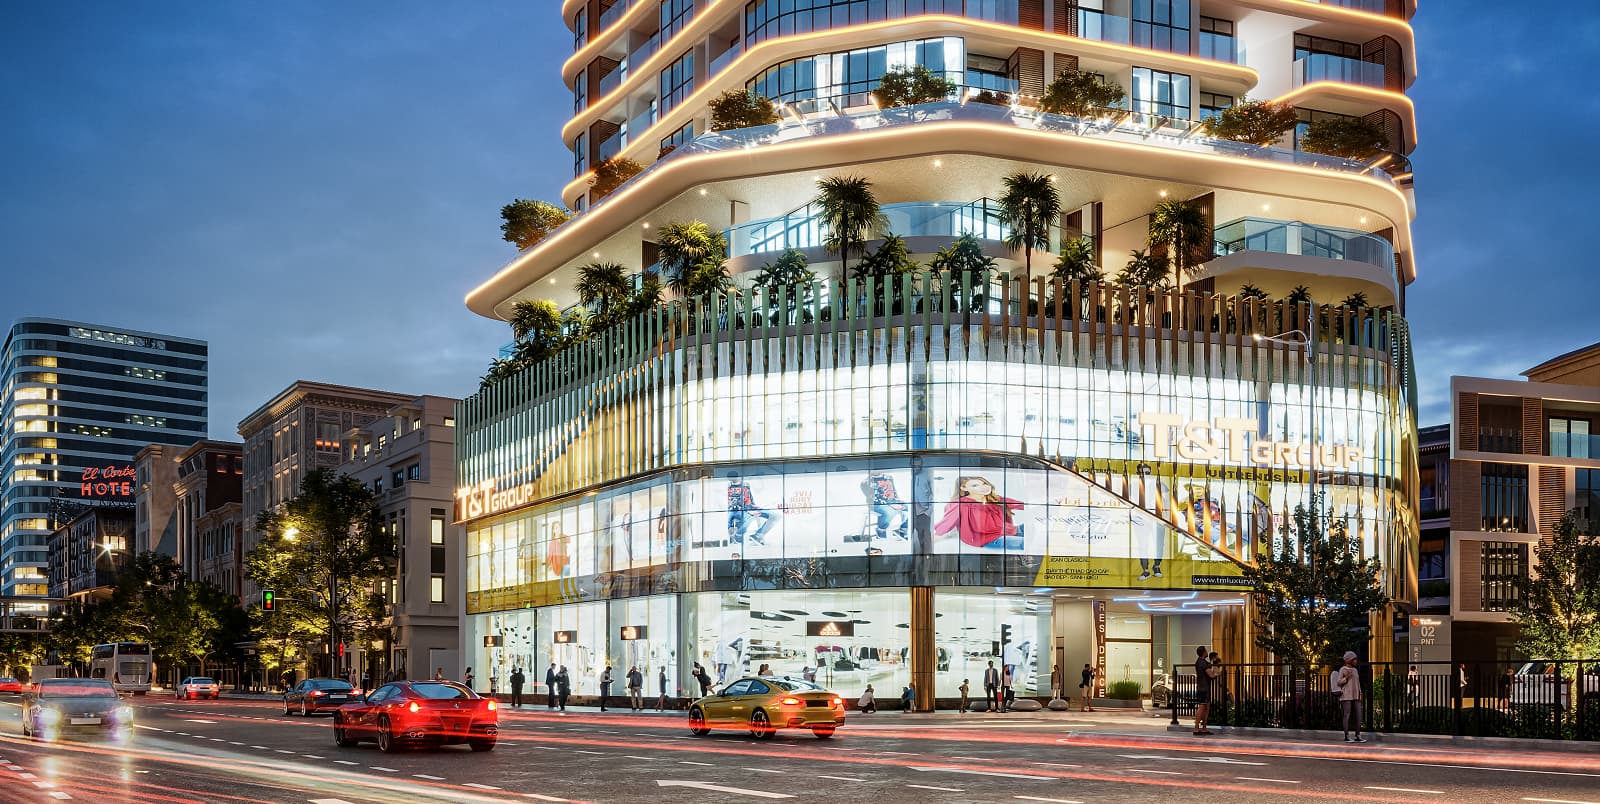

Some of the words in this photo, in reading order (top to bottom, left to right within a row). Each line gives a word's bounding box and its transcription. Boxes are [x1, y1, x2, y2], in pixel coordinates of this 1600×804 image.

[1139, 412, 1258, 462] T&T
[1250, 441, 1364, 468] GROUP
[457, 478, 497, 520] T&T
[492, 483, 535, 512] GROUP
[1194, 577, 1256, 585] www.tmluxury.v
[1421, 626, 1435, 637] 02
